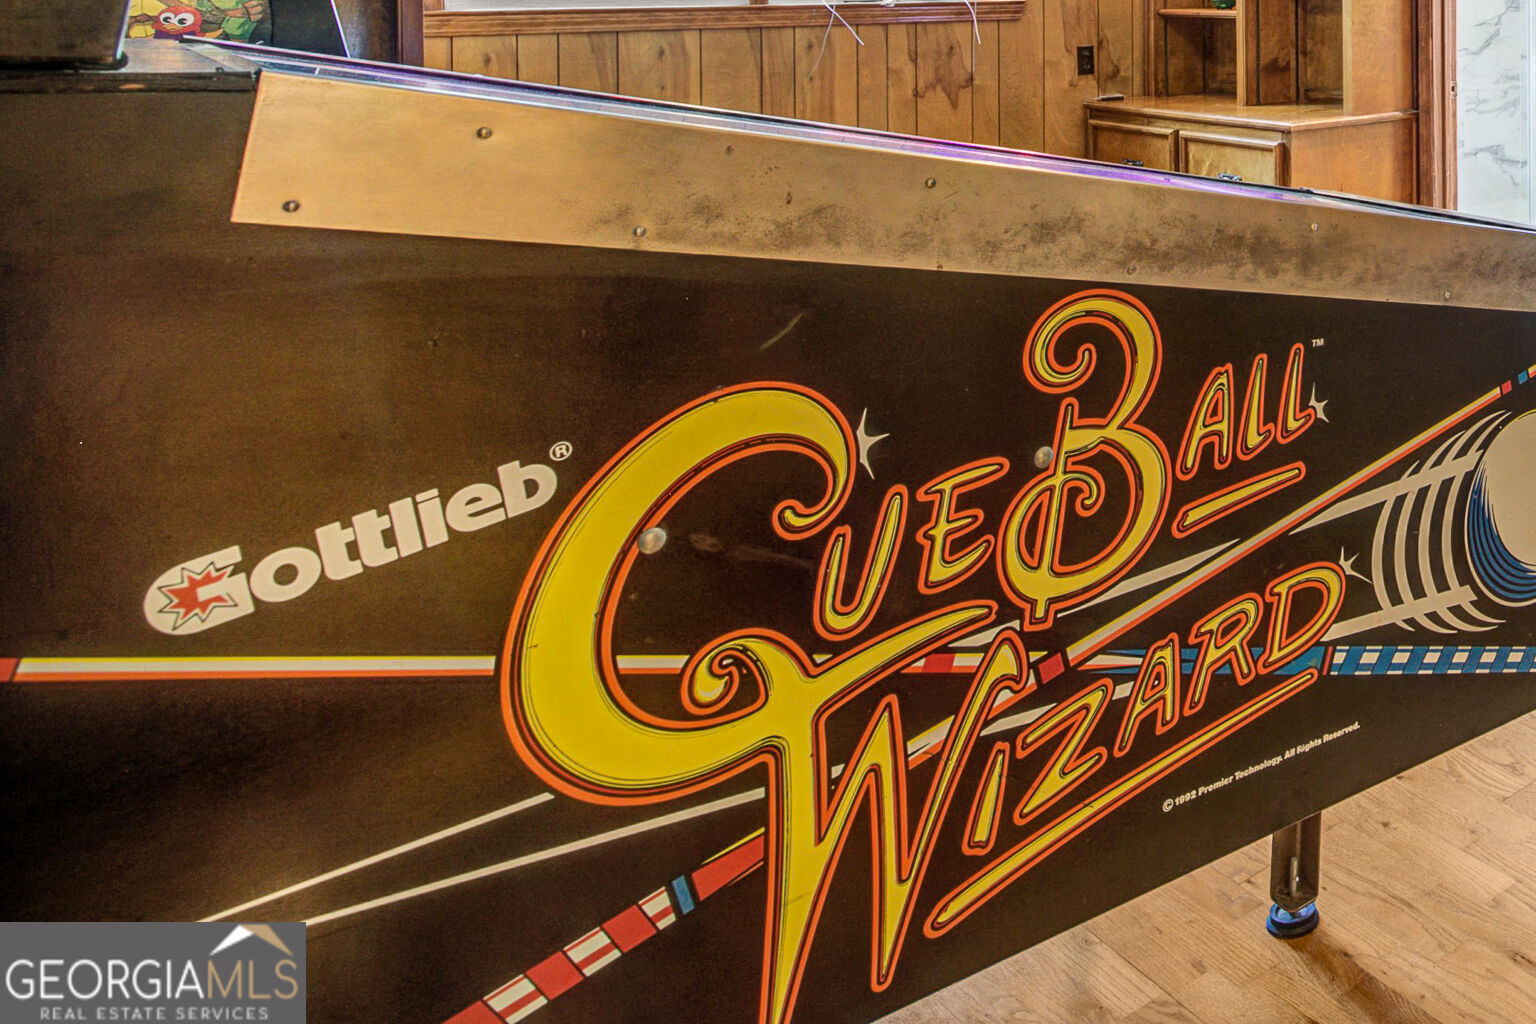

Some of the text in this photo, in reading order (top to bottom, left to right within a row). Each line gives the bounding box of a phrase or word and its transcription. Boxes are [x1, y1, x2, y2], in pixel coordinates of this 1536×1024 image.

[143, 459, 558, 636] Gottlieb
[1174, 789, 1197, 807] 1992
[1198, 775, 1234, 797] Premier
[1234, 754, 1284, 781] Technology.
[1284, 747, 1296, 760] All
[1296, 737, 1323, 755] Rights
[1322, 721, 1361, 744] Reserved.
